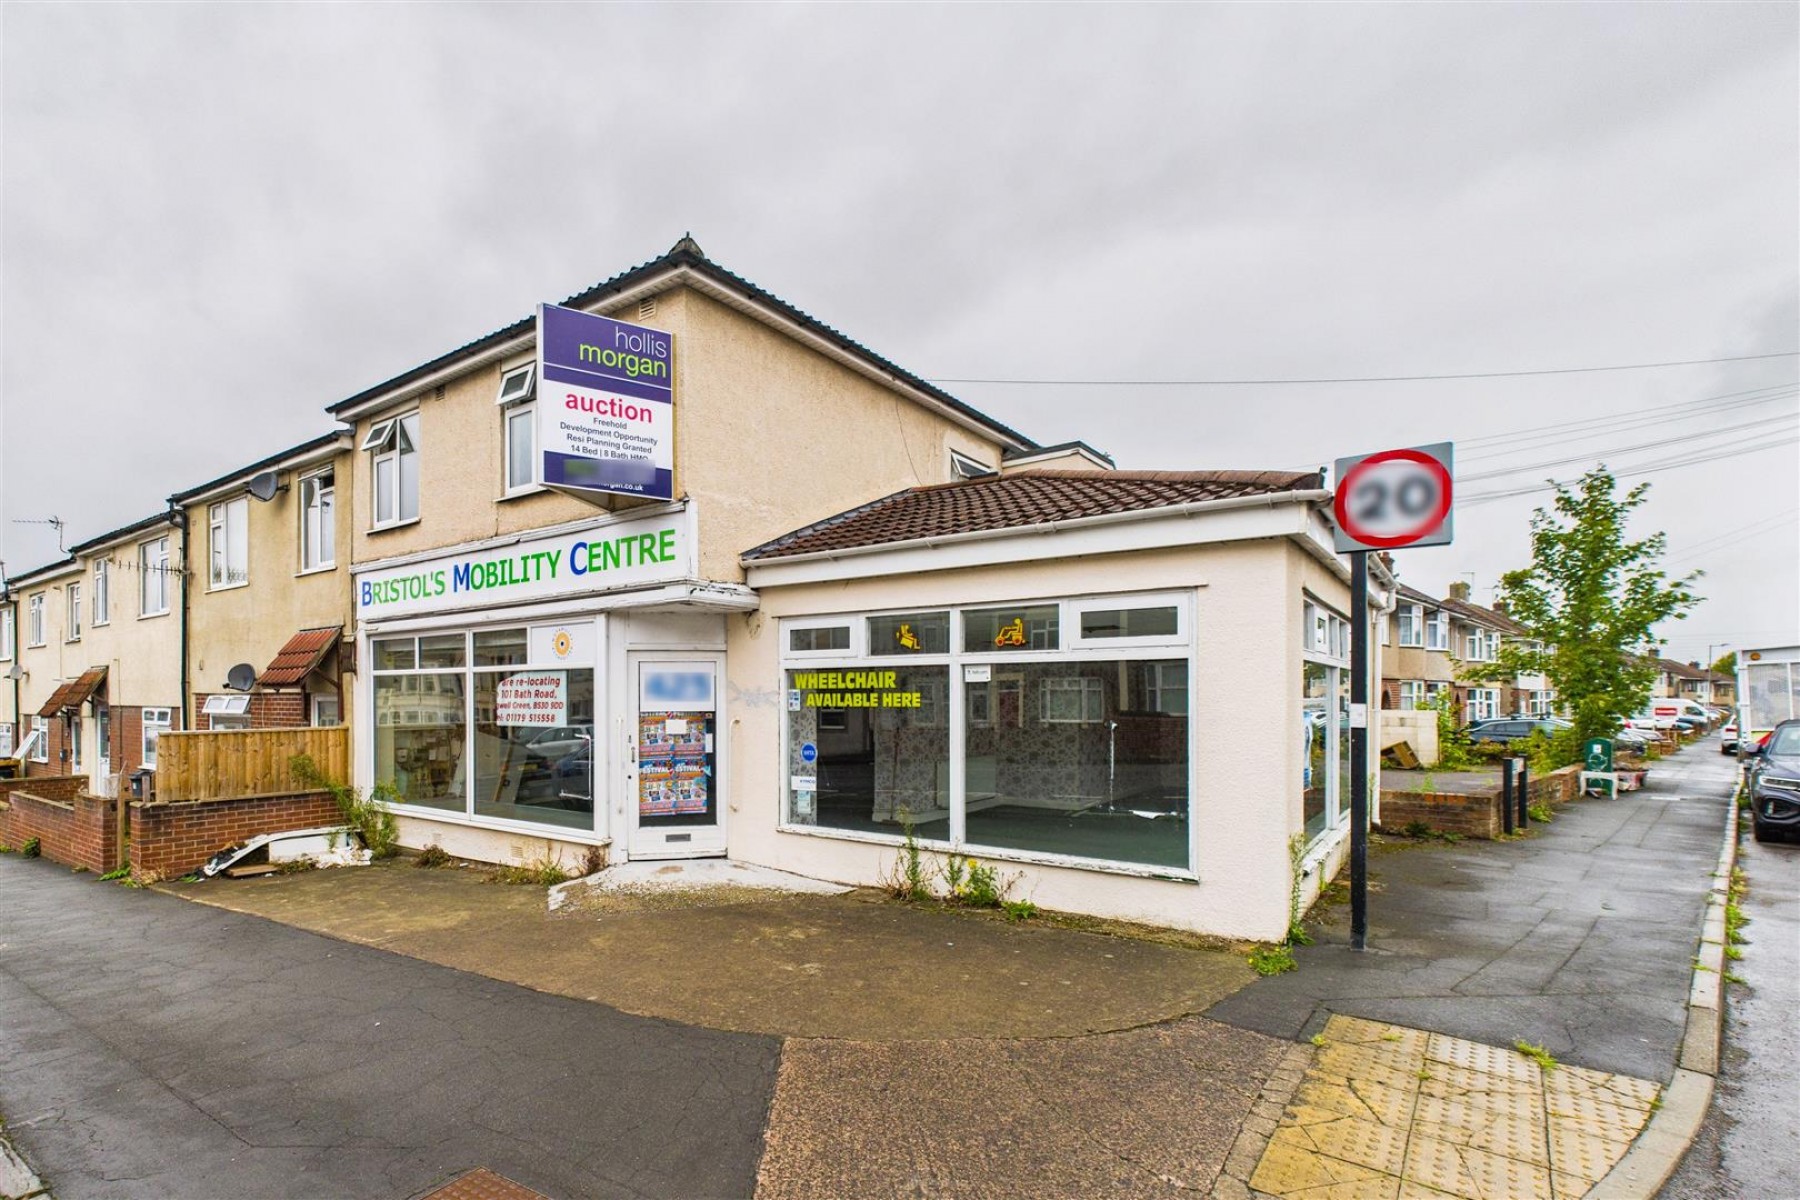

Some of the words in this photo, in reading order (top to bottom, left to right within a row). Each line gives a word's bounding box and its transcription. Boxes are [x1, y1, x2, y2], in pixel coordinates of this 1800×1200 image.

[615, 326, 667, 359] hollis
[579, 343, 666, 378] morgan
[565, 393, 652, 423] auction
[560, 421, 612, 438] Development
[613, 431, 658, 446] Opportunity
[593, 417, 628, 430] Freehold
[566, 432, 585, 444] Resi
[586, 436, 621, 450] Planning
[622, 442, 652, 454] Granted
[571, 444, 581, 453] 14
[582, 445, 598, 455] Bed
[603, 449, 609, 458] 8
[610, 450, 629, 460] Bath
[1356, 475, 1436, 519] 20
[361, 570, 446, 607] BRISTOL'S
[453, 549, 562, 593] MOBILITY
[570, 529, 676, 576] CENTRE
[502, 679, 514, 687] are
[516, 676, 560, 688] re-locating
[794, 671, 897, 689] WHEELCHAIR
[502, 690, 512, 698] 101
[514, 689, 532, 699] Bath
[806, 692, 879, 708] AVAILABLE
[882, 692, 921, 708] HERE
